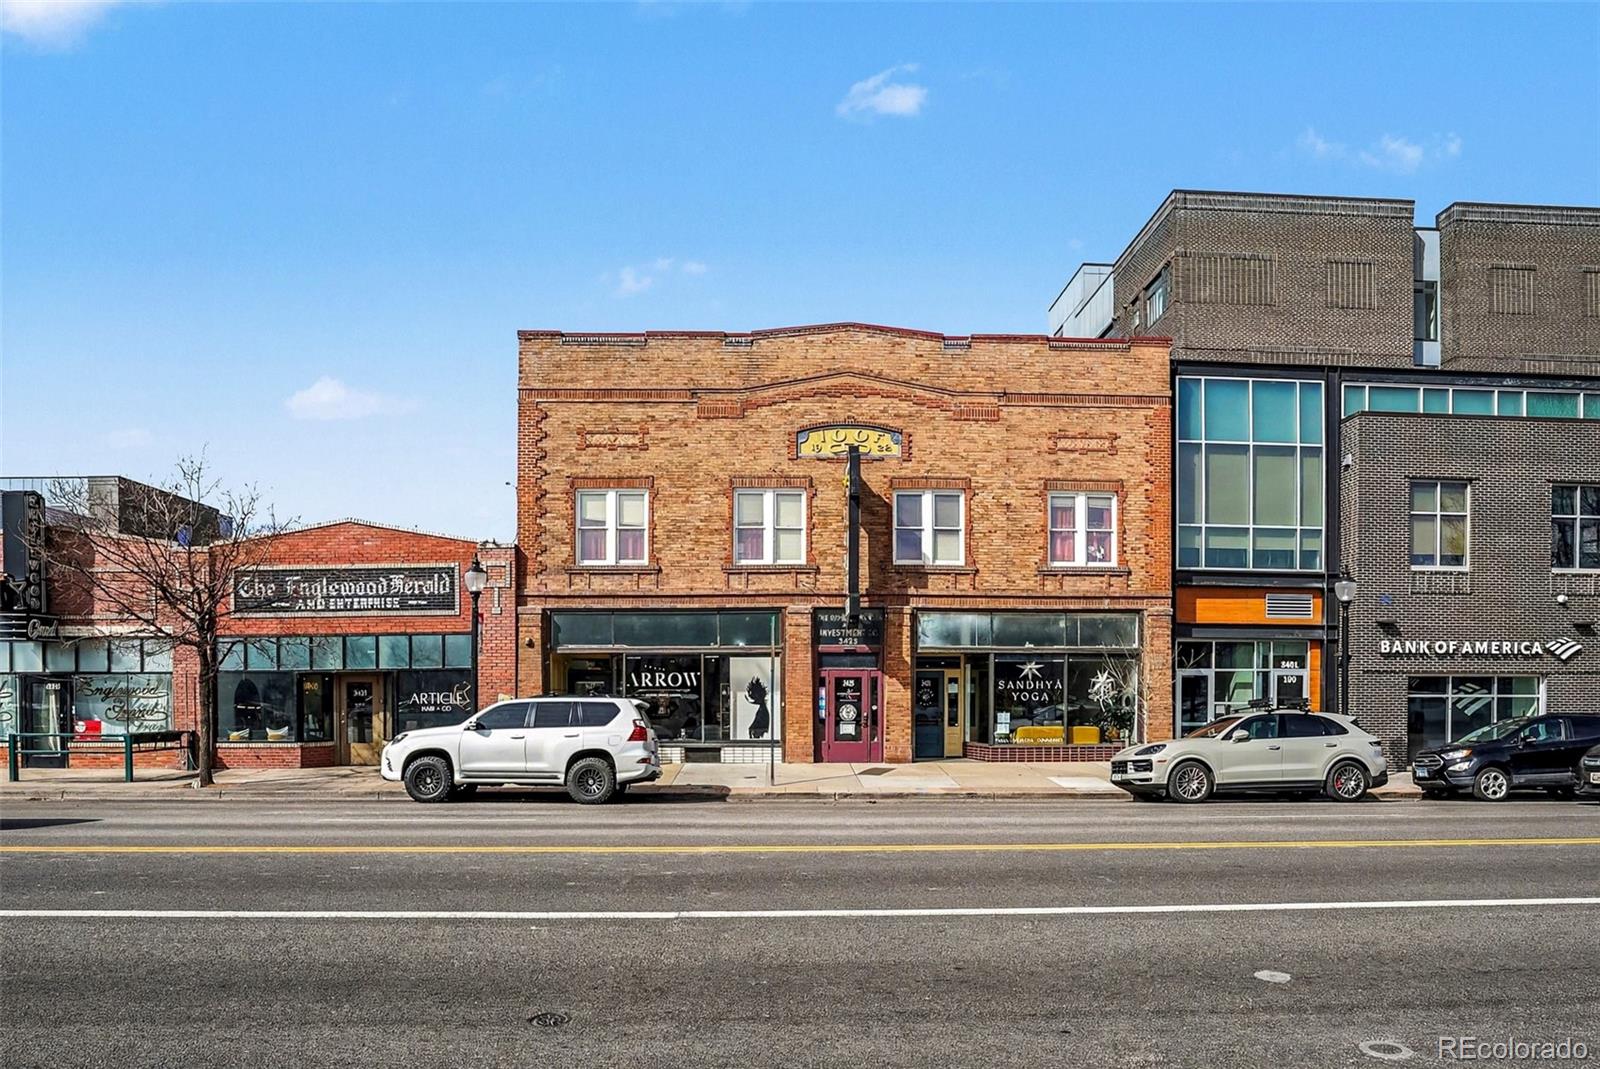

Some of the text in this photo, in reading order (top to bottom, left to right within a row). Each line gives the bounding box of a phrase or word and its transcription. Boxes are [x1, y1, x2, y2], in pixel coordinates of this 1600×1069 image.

[237, 573, 450, 600] The Englewood Herald
[296, 599, 326, 610] AND
[328, 597, 400, 609] ENTERPRISE
[1380, 640, 1543, 655] BANK OF AMERICA
[626, 672, 701, 687] ARROW
[998, 679, 1063, 690] SANDHYA
[409, 691, 464, 705] ARTICLE
[1012, 691, 1049, 702] YOGA
